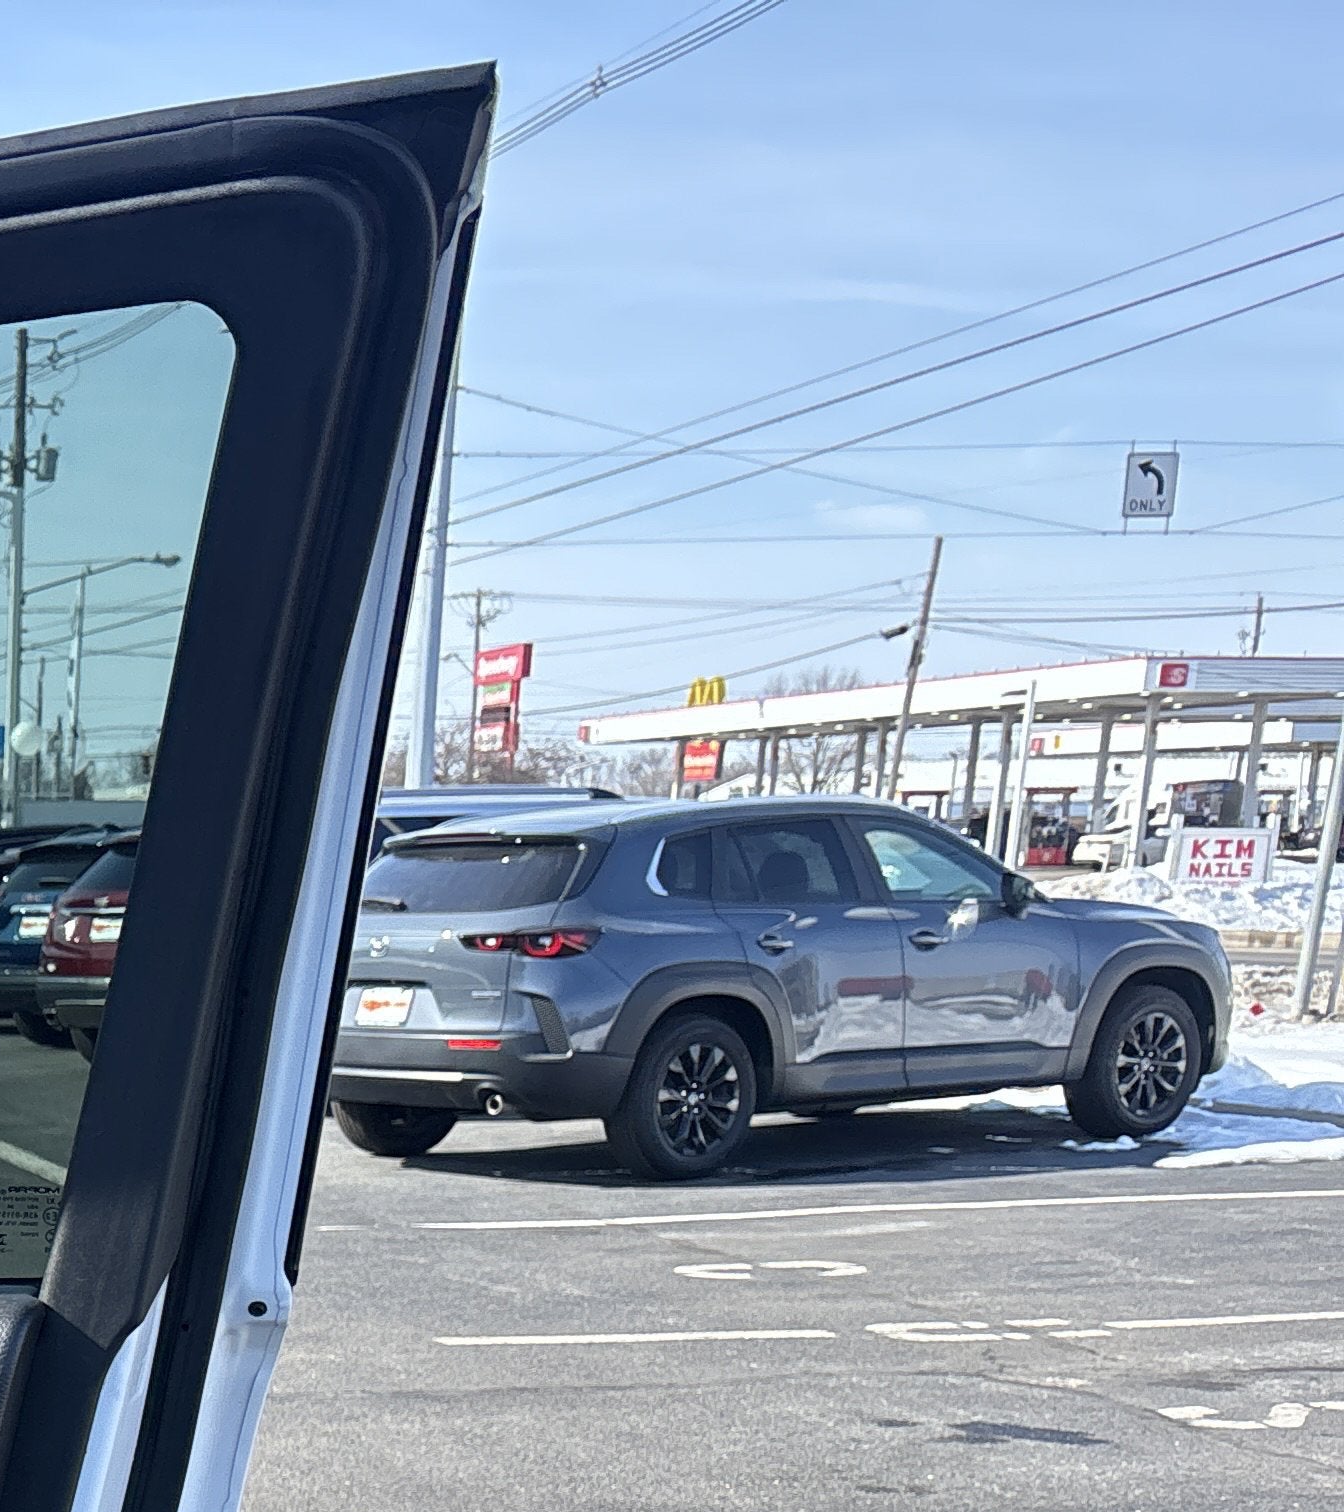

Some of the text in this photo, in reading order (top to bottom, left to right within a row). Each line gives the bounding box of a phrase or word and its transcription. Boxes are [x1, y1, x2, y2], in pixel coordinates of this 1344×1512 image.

[1129, 498, 1167, 512] ONLY
[1191, 838, 1256, 859] KIM
[1188, 862, 1253, 878] NAILS
